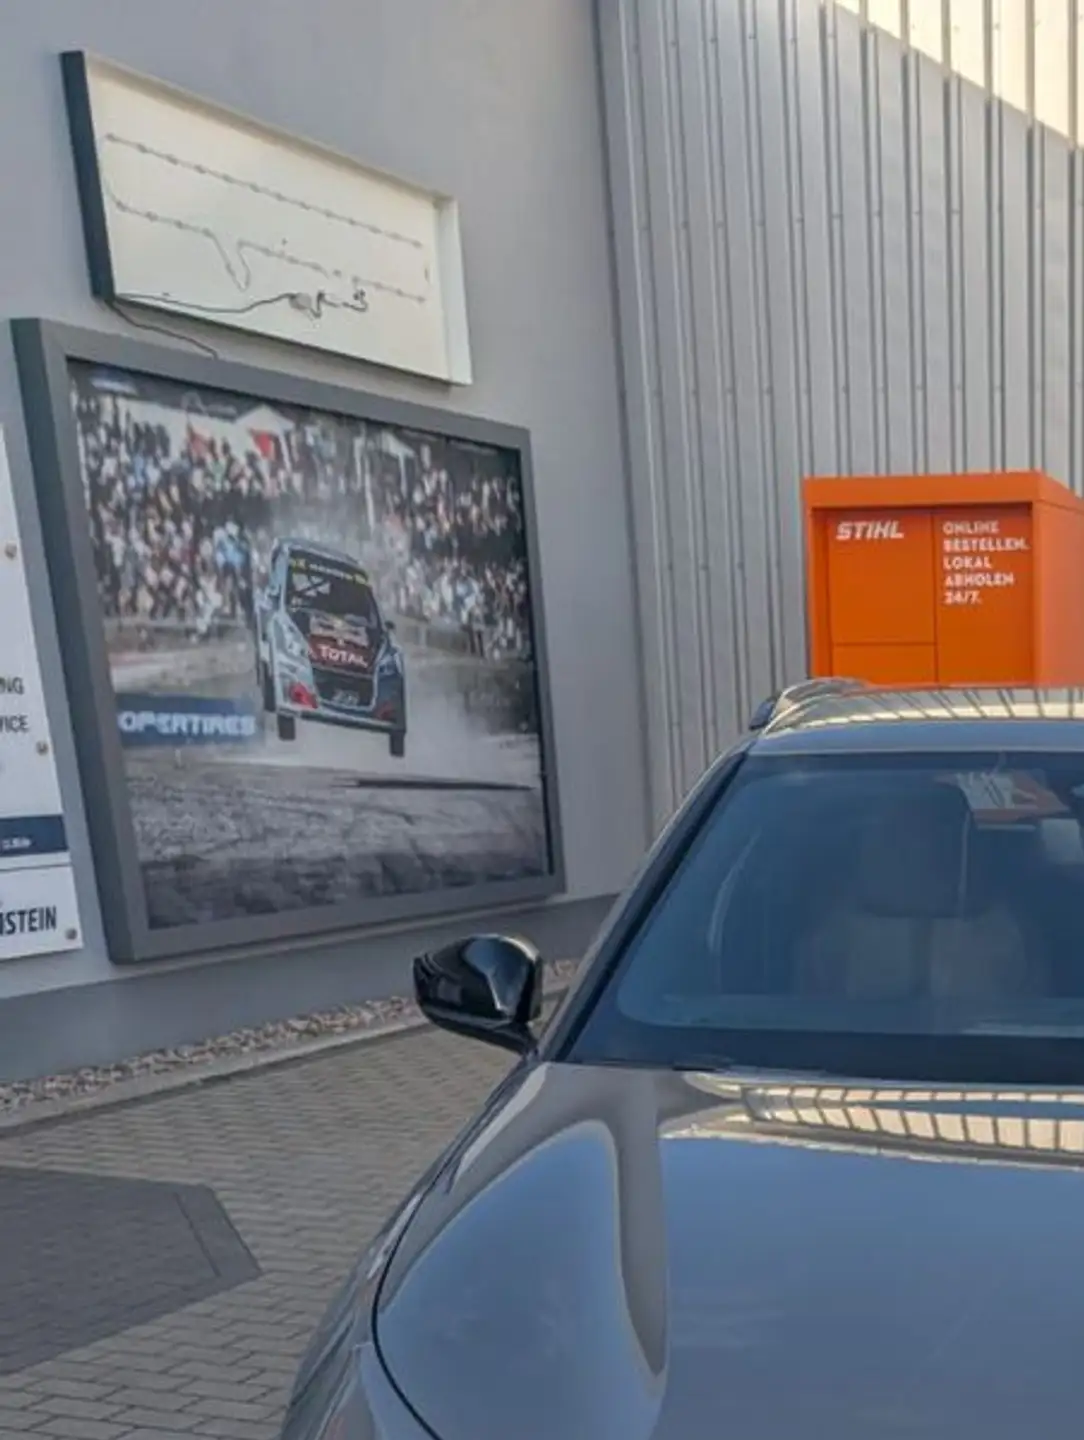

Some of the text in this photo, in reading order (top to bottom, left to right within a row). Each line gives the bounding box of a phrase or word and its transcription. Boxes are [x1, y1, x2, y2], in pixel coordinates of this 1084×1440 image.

[836, 520, 903, 540] STIHL
[943, 521, 999, 535] ONLINE
[943, 556, 992, 570] LOKAL
[945, 573, 1014, 587] ABHOLEN
[318, 644, 369, 668] TOTAL
